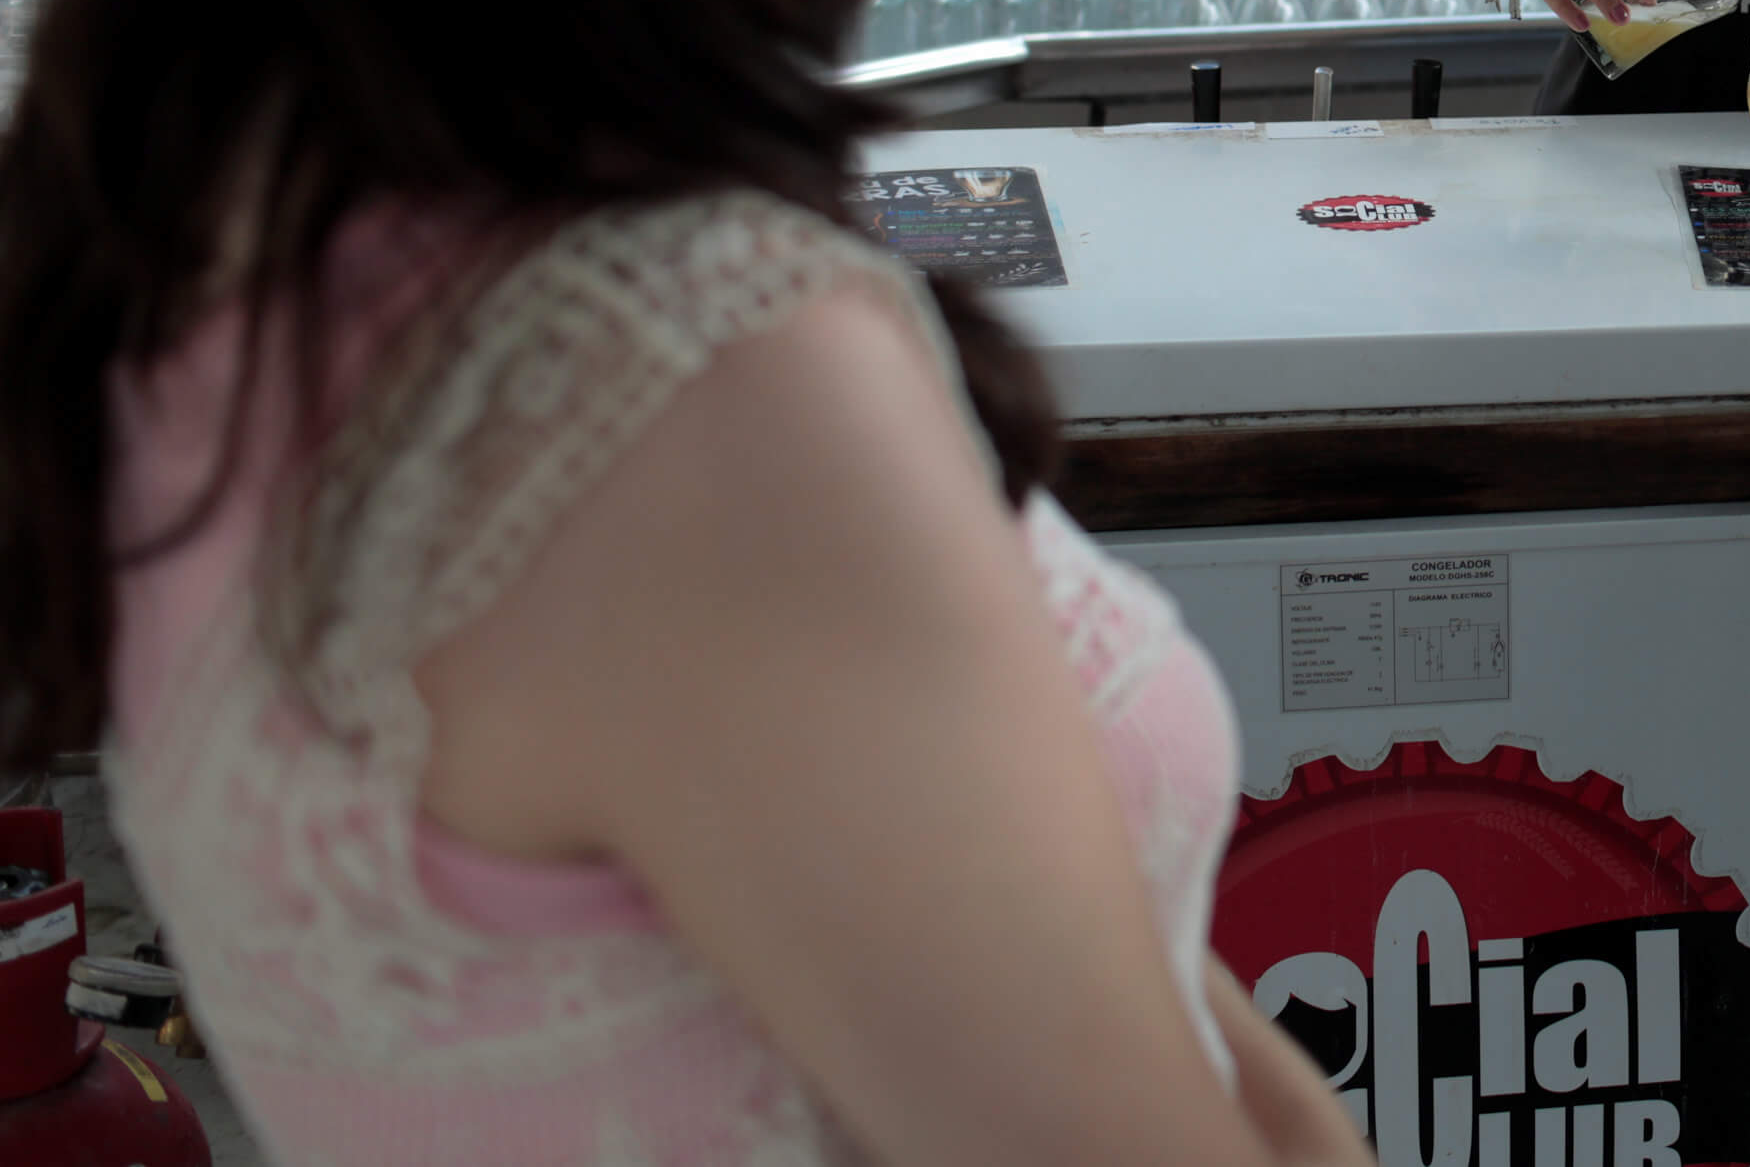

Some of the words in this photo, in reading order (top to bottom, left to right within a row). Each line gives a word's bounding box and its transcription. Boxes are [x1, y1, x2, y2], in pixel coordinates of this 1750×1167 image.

[1411, 559, 1492, 571] CONGELADOR
[1409, 573, 1446, 582] MODELO
[1408, 594, 1448, 602] DIAGRAMA
[1451, 591, 1493, 600] ELECTRICO
